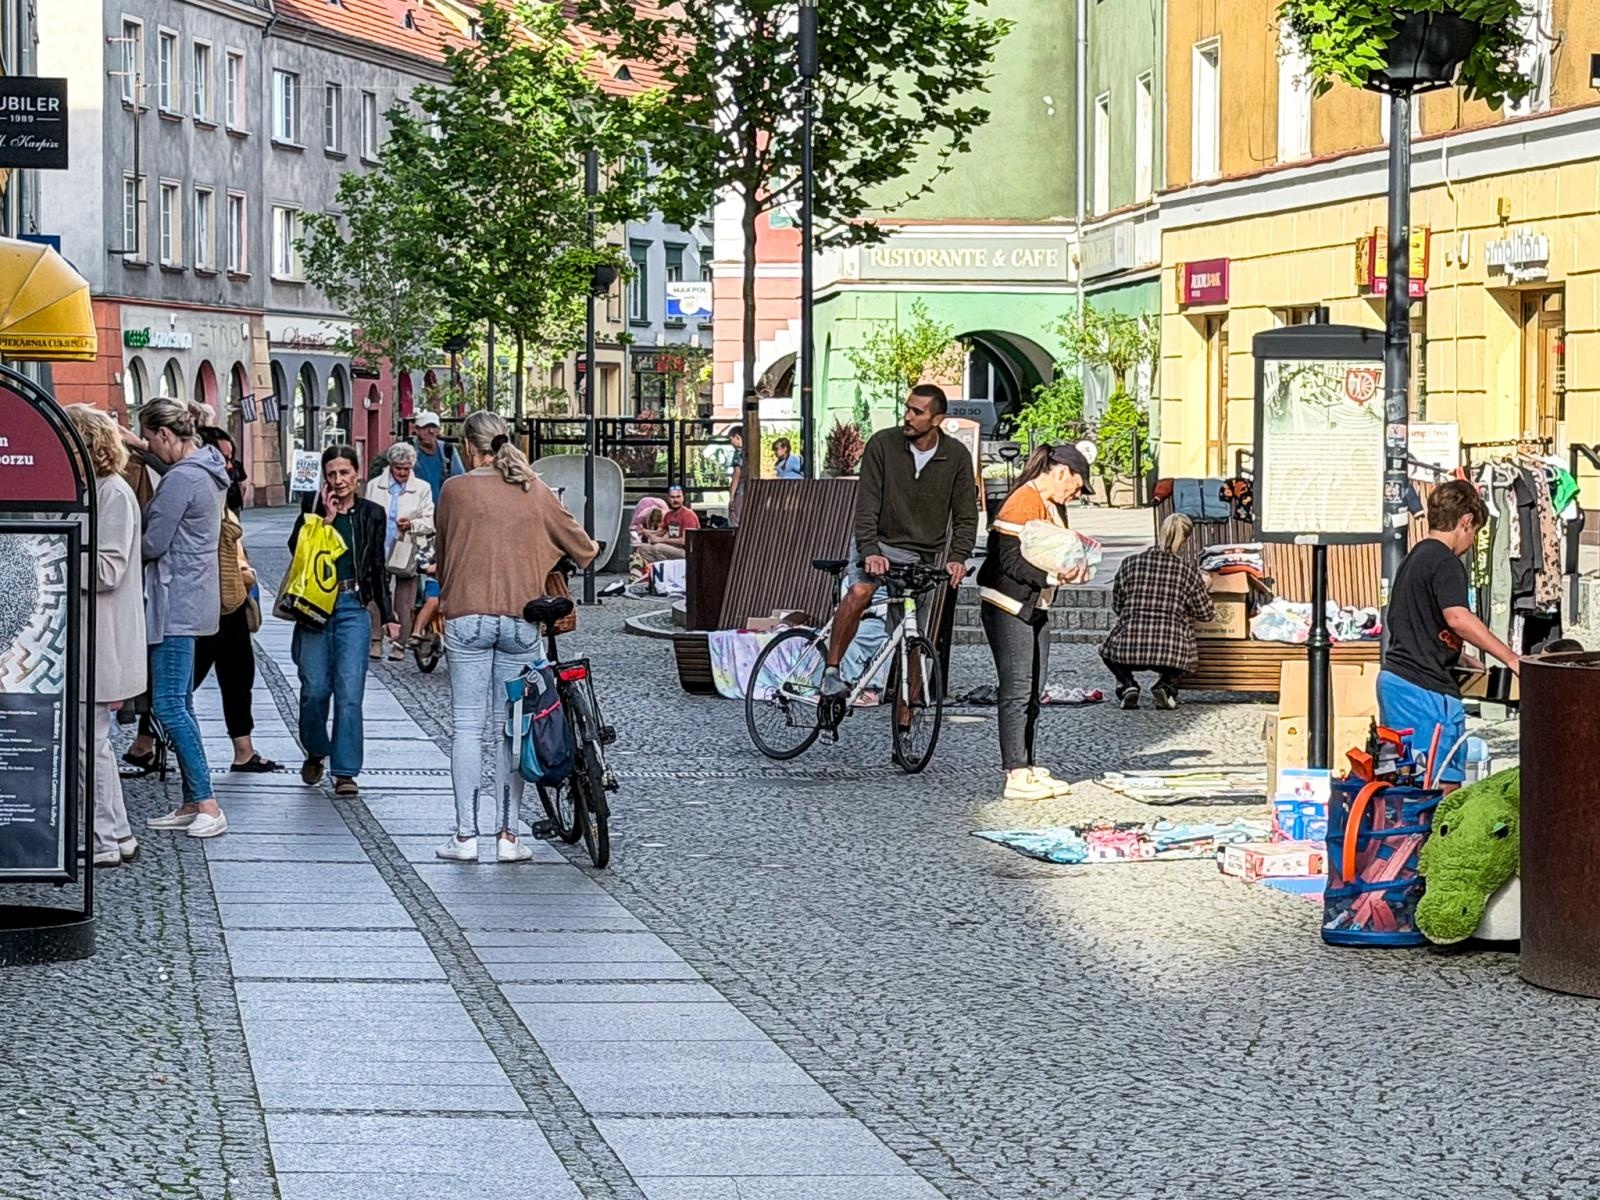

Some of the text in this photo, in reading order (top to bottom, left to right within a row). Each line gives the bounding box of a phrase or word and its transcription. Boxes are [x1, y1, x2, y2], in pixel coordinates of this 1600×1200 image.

[10, 114, 34, 123] 1989
[870, 248, 988, 268] RISTORANTE
[992, 249, 1006, 267] &
[1010, 248, 1058, 268] CAFE
[0, 454, 35, 465] orzu
